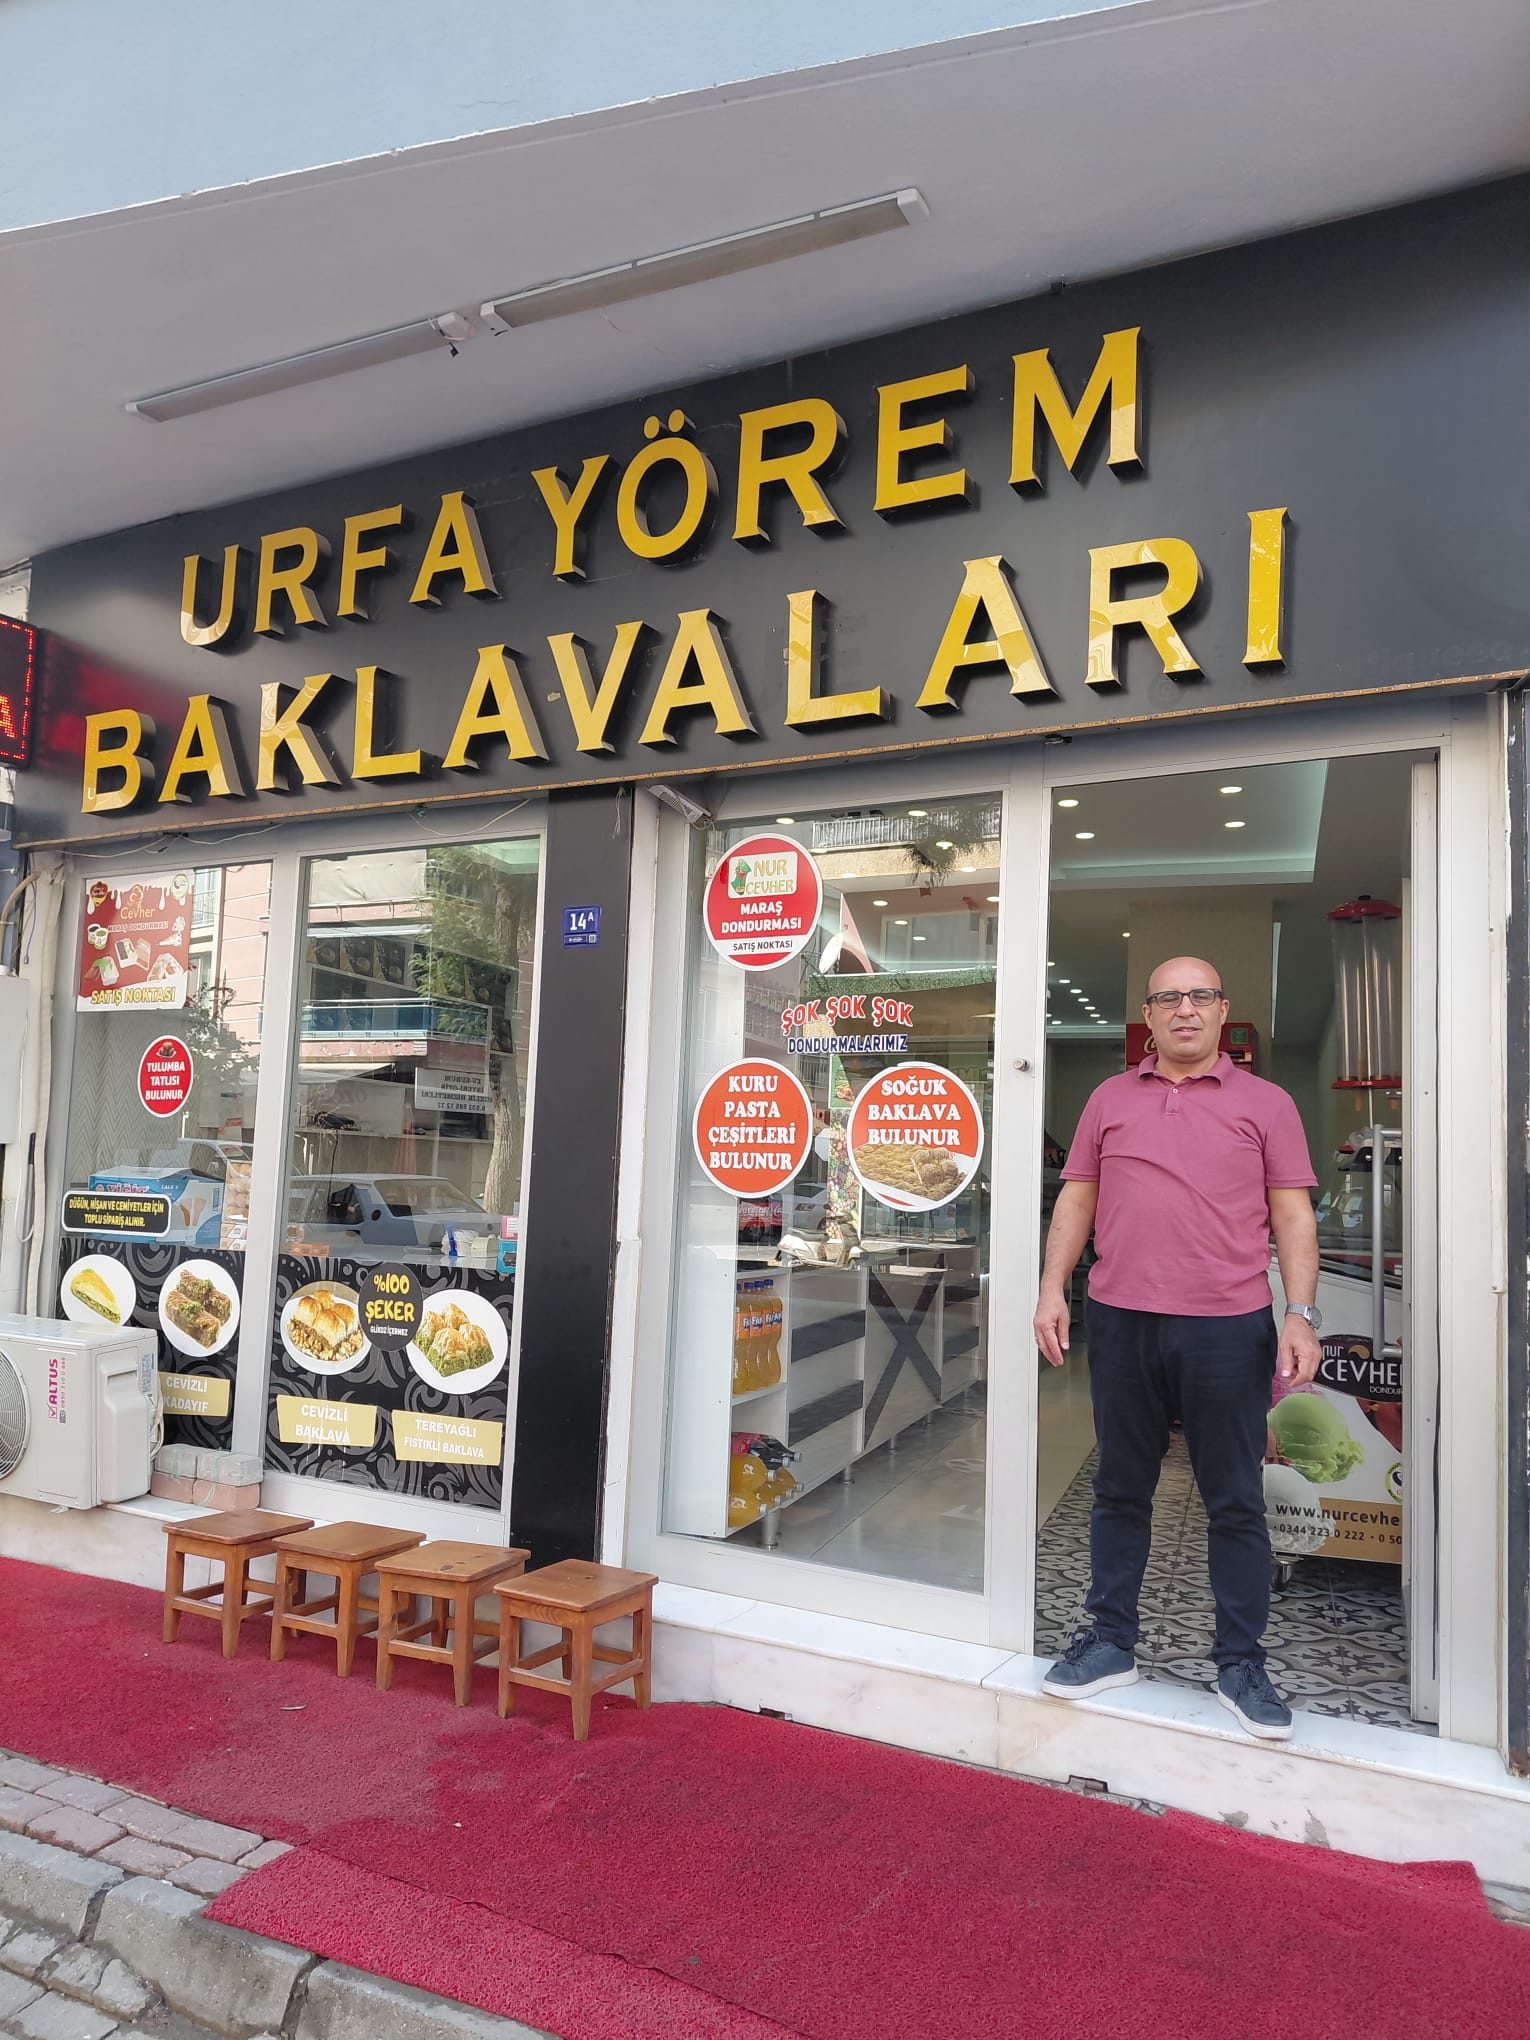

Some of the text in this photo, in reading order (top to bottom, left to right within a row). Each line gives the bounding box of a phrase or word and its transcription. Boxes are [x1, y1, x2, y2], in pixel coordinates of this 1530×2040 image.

[179, 326, 1145, 649] URFA YÖREM
[81, 507, 1290, 814] BAKLAVALARI
[753, 858, 788, 878] NUR
[745, 879, 794, 895] CEVHER
[740, 900, 783, 917] MARAŞ
[721, 917, 802, 934] DONDURMASI
[733, 940, 793, 952] SATIŞ NOKTASI
[90, 986, 176, 1005] SATIŞ NOKTASI
[782, 995, 914, 1036] ŞOK ŞOK ŞOK
[788, 1034, 908, 1054] DONDURMALARIMIZ
[147, 1061, 186, 1073] TULUMBA
[150, 1075, 180, 1087] TATLISI
[728, 1075, 778, 1093] KURU
[881, 1075, 948, 1097] SOĞUK
[145, 1089, 184, 1101] BULUNUR
[724, 1101, 781, 1118] PASTA
[867, 1104, 962, 1121] BAKLAVA
[708, 1122, 797, 1147] ÇEŞİTLERİ
[867, 1127, 961, 1147] BULUNUR
[709, 1151, 793, 1171] BULUNUR
[90, 1197, 108, 1212] NİŞAN
[107, 1200, 116, 1211] VE
[115, 1199, 151, 1213] CEMİYETLER
[151, 1200, 164, 1216] İÇİN
[84, 1213, 104, 1225] TOPLU
[103, 1212, 124, 1229] SİPARİŞ
[373, 1272, 410, 1295] %100
[365, 1299, 415, 1325] ŞEKER
[1322, 1344, 1345, 1360] nur
[48, 1358, 59, 1405] ALTUS
[1320, 1358, 1403, 1386] CEVHE
[166, 1376, 208, 1393] CEVİZLİ
[165, 1397, 209, 1413] KADAYIF
[301, 1404, 348, 1422] CEVİZLİ
[295, 1424, 350, 1444] BAKLAVA
[415, 1418, 477, 1438] TEREYAĞLI
[404, 1436, 484, 1459] FISTIKLI BAKLAVA
[1275, 1504, 1400, 1527] www.nurcevhe
[1279, 1523, 1403, 1545] 0344 223 0 222 0 50
